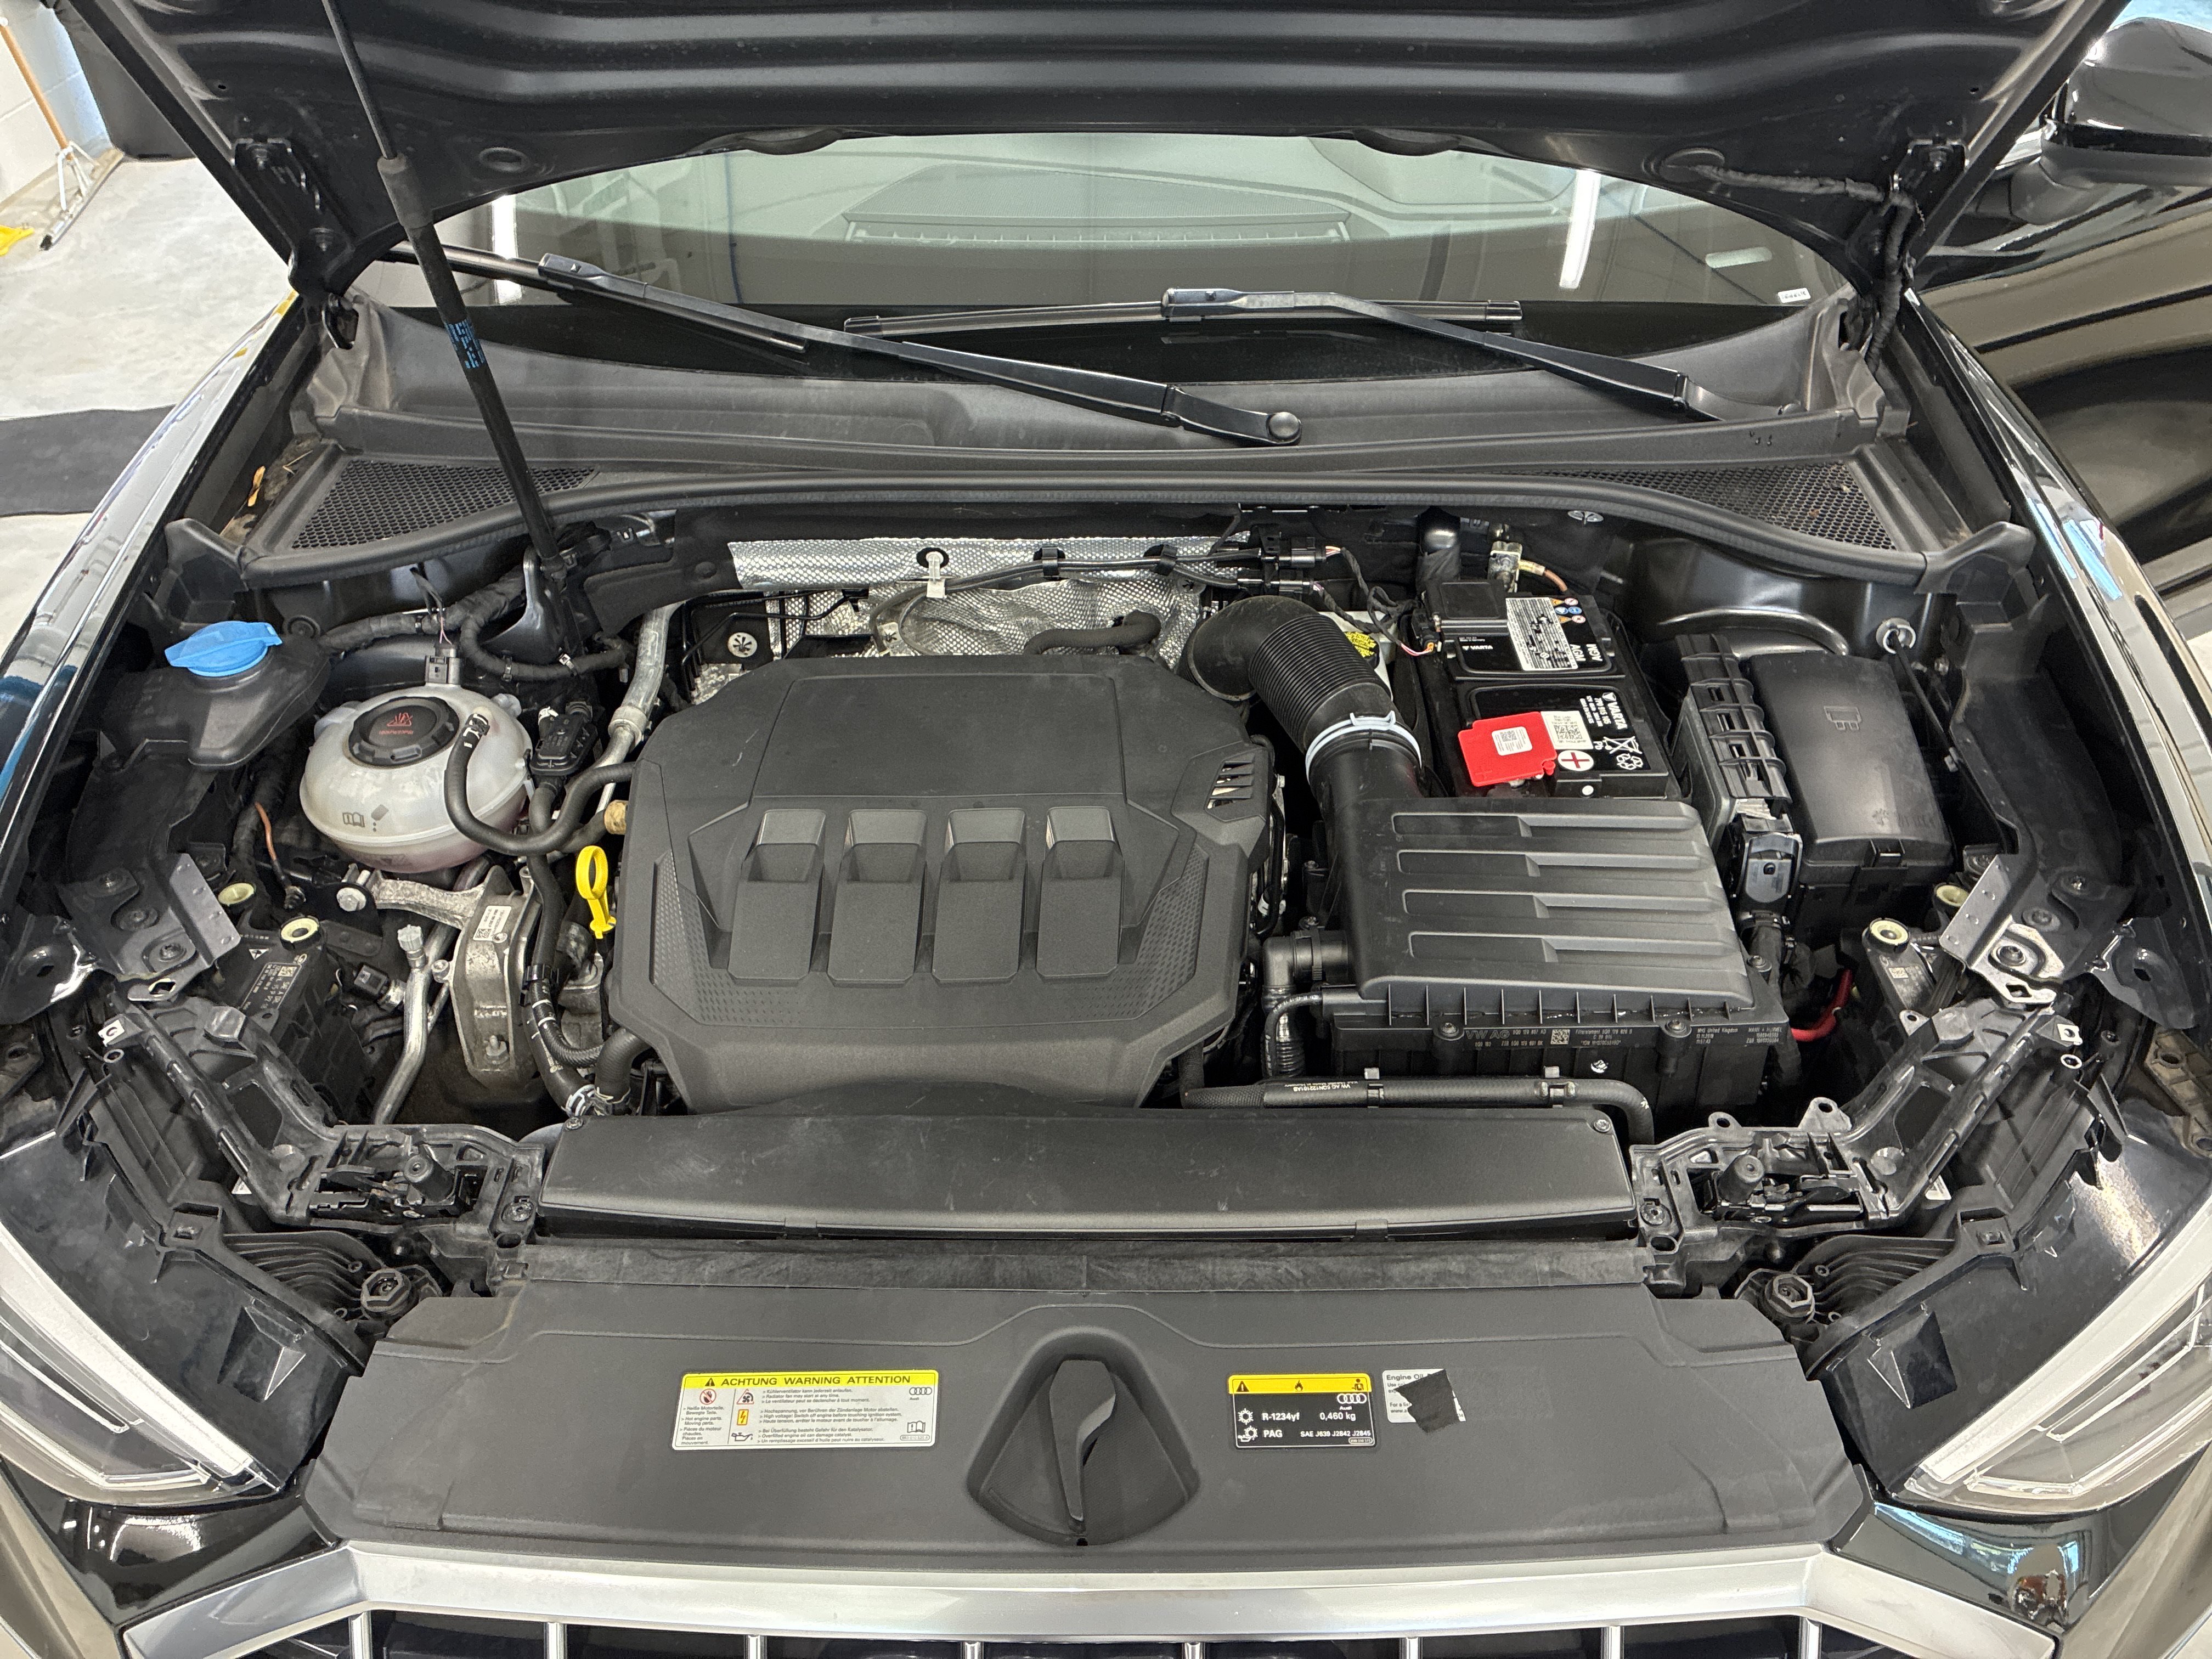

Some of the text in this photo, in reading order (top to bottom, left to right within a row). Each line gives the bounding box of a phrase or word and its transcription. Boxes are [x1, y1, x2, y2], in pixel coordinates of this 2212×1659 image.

[1570, 644, 1586, 661] AGM
[1586, 644, 1603, 662] AGM
[1607, 702, 1628, 730] VARTA
[1593, 741, 1604, 750] Pb
[1466, 1030, 1510, 1039] VW AG
[721, 1375, 911, 1386] ACHTUNG WARNING ATTENTION
[1262, 1412, 1356, 1422] R-1234yf 0,460 kg
